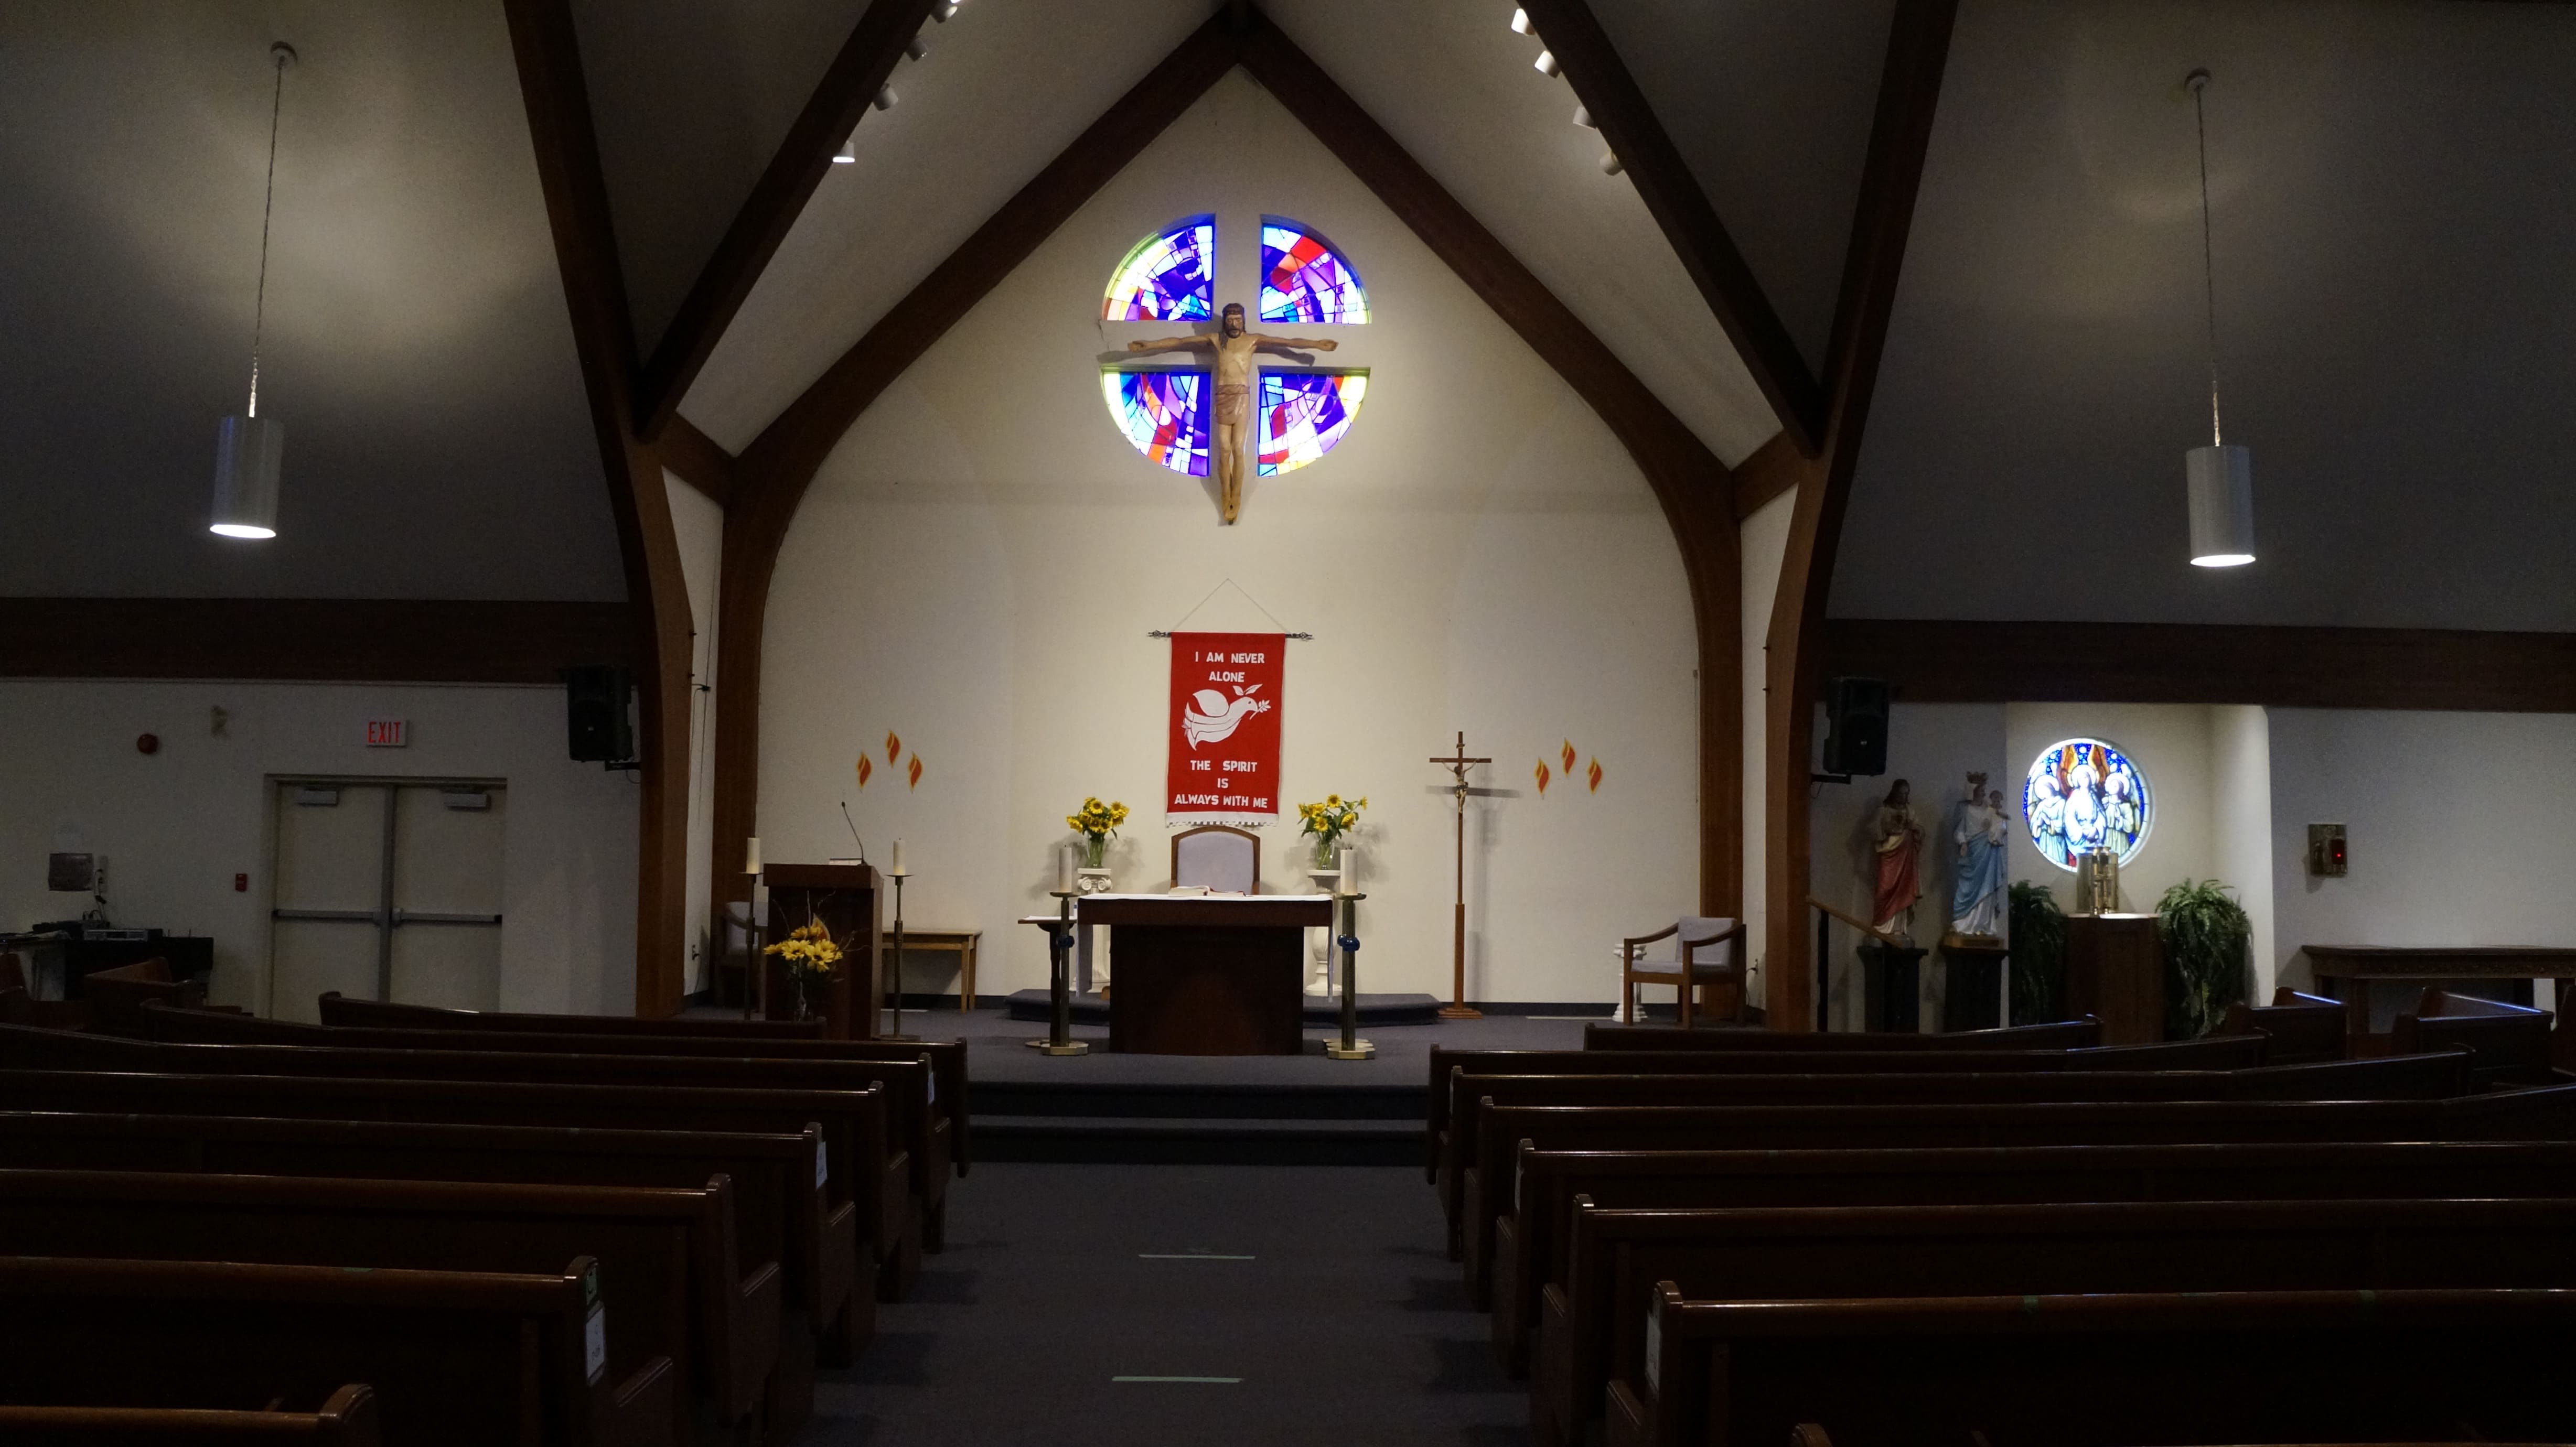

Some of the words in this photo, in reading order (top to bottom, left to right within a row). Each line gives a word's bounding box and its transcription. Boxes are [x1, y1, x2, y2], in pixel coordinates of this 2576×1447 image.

[1196, 652, 1198, 662] I
[1206, 652, 1223, 662] AM
[1231, 653, 1264, 663] NEVER
[1209, 672, 1244, 682] ALONE
[368, 721, 401, 743] EXIT
[1190, 760, 1210, 770] THE
[1223, 761, 1257, 772] SPIRIT
[1218, 778, 1228, 788] IS
[1175, 794, 1219, 805] ALWAYS
[1223, 796, 1249, 806] WITH
[1253, 797, 1268, 808] ME
